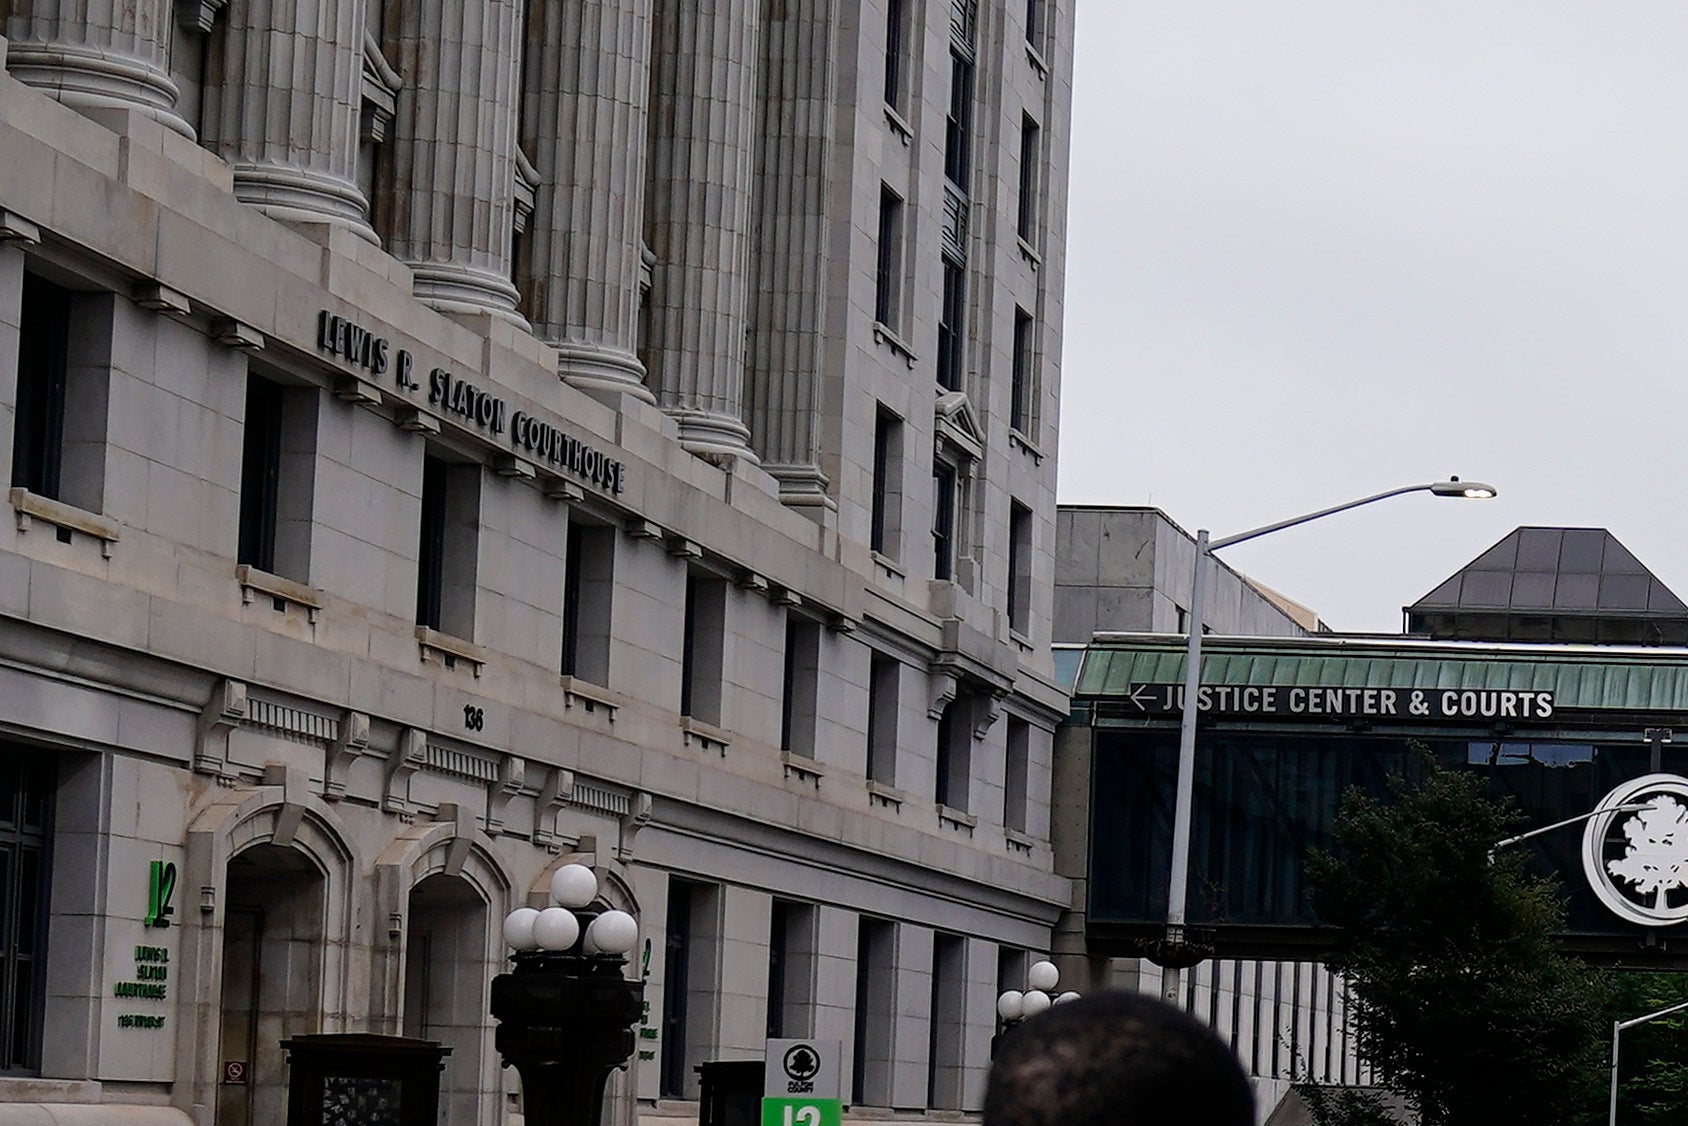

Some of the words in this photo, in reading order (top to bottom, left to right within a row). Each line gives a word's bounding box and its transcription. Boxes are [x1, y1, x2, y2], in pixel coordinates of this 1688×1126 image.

[318, 309, 390, 375] LEWIS
[397, 349, 420, 391] R.
[429, 367, 505, 434] SLATON
[512, 410, 626, 494] COURTHOUSE
[463, 704, 484, 732] 136
[1289, 688, 1397, 716] CENTER
[1409, 691, 1429, 716] &
[1441, 690, 1553, 718] COURTS
